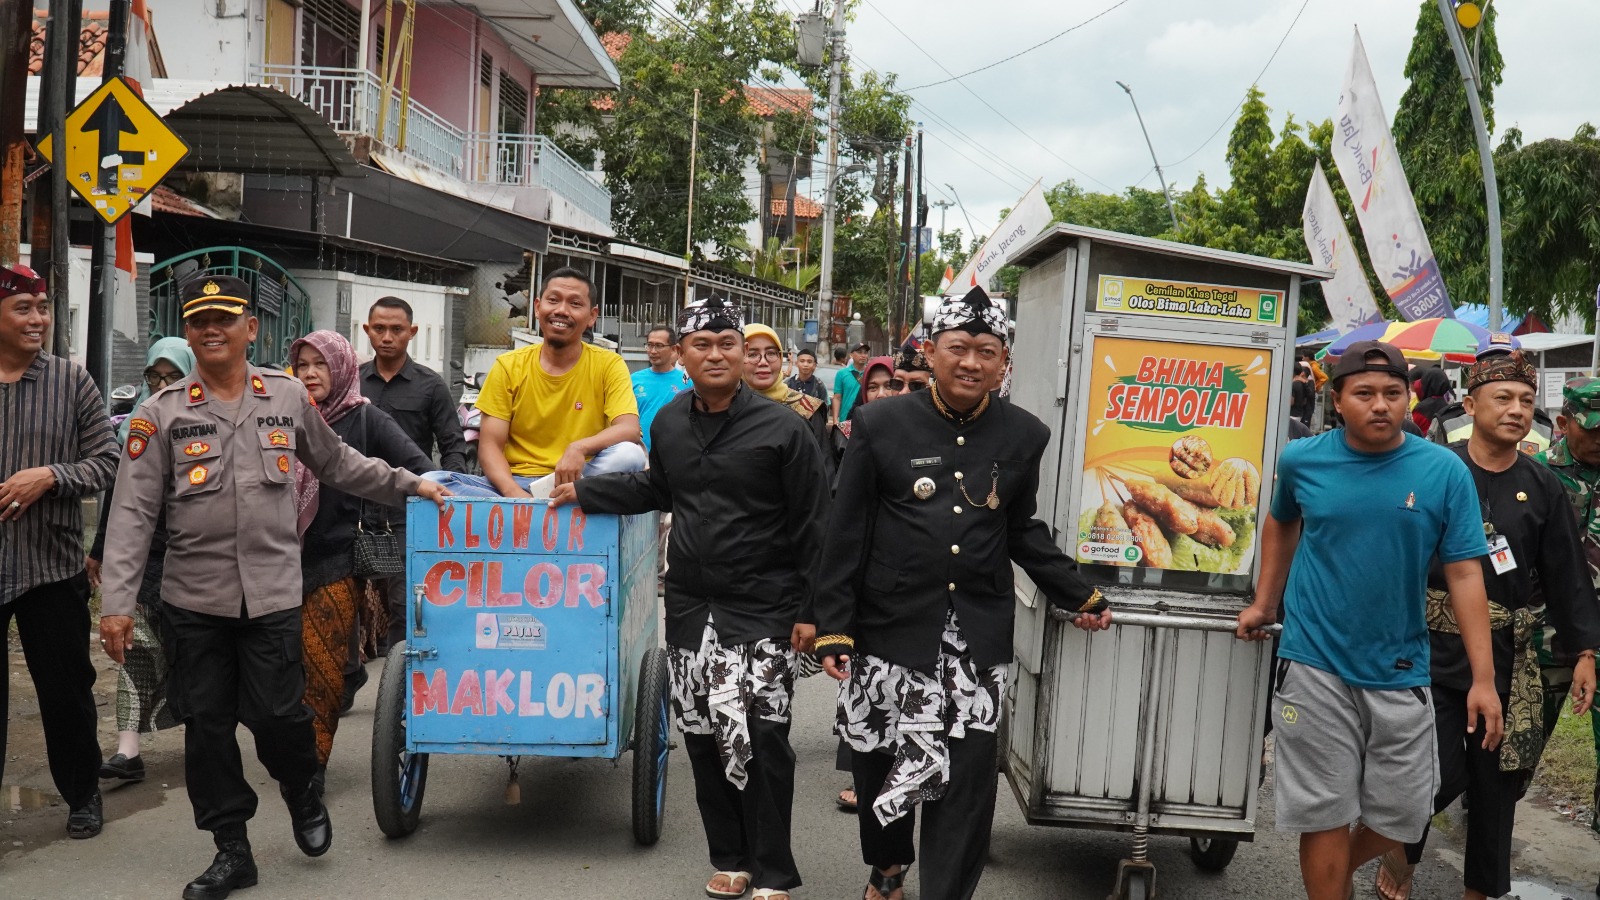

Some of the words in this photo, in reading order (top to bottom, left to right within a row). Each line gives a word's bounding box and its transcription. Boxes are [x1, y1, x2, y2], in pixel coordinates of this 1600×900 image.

[976, 251, 999, 272] Bank
[998, 224, 1026, 255] Jateng
[1128, 295, 1154, 309] Olos
[1156, 297, 1186, 312] Bima
[1188, 299, 1251, 318] Laka-Laka
[1146, 284, 1183, 297] Cemilan
[1186, 287, 1210, 299] Khas
[1212, 289, 1238, 302] Tegal
[1136, 356, 1224, 388] BHIMA
[1104, 384, 1250, 429] SEMPOLAN
[171, 423, 218, 440] SURATMAN
[257, 416, 293, 428] POLRI
[438, 503, 587, 551] KLOWOR
[1090, 545, 1120, 553] gofood
[423, 560, 607, 608] CILOR
[503, 625, 541, 637] PAJAK
[412, 668, 606, 719] MAKLOR
